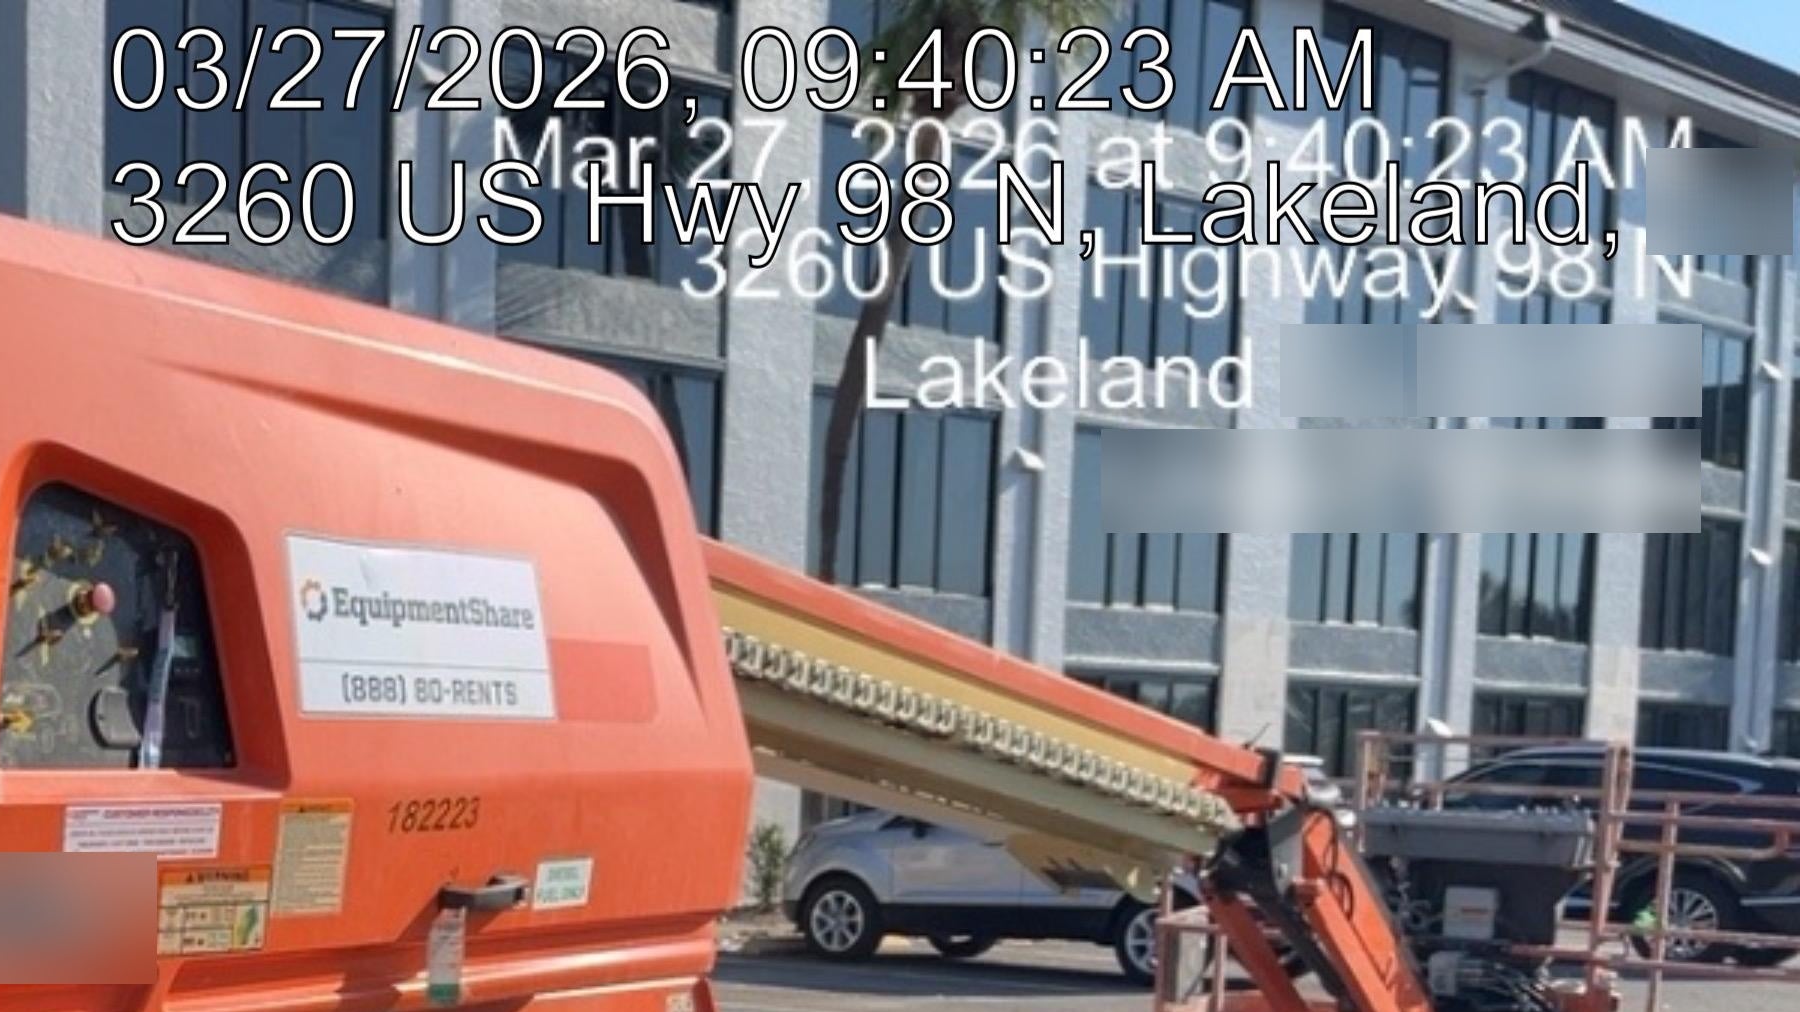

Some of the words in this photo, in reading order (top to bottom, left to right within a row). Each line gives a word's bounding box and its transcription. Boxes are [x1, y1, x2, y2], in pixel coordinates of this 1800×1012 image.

[331, 586, 535, 630] EquipmentShare
[341, 672, 406, 705] (888)
[413, 675, 519, 706] 80-RENTS
[388, 797, 481, 834] 182223
